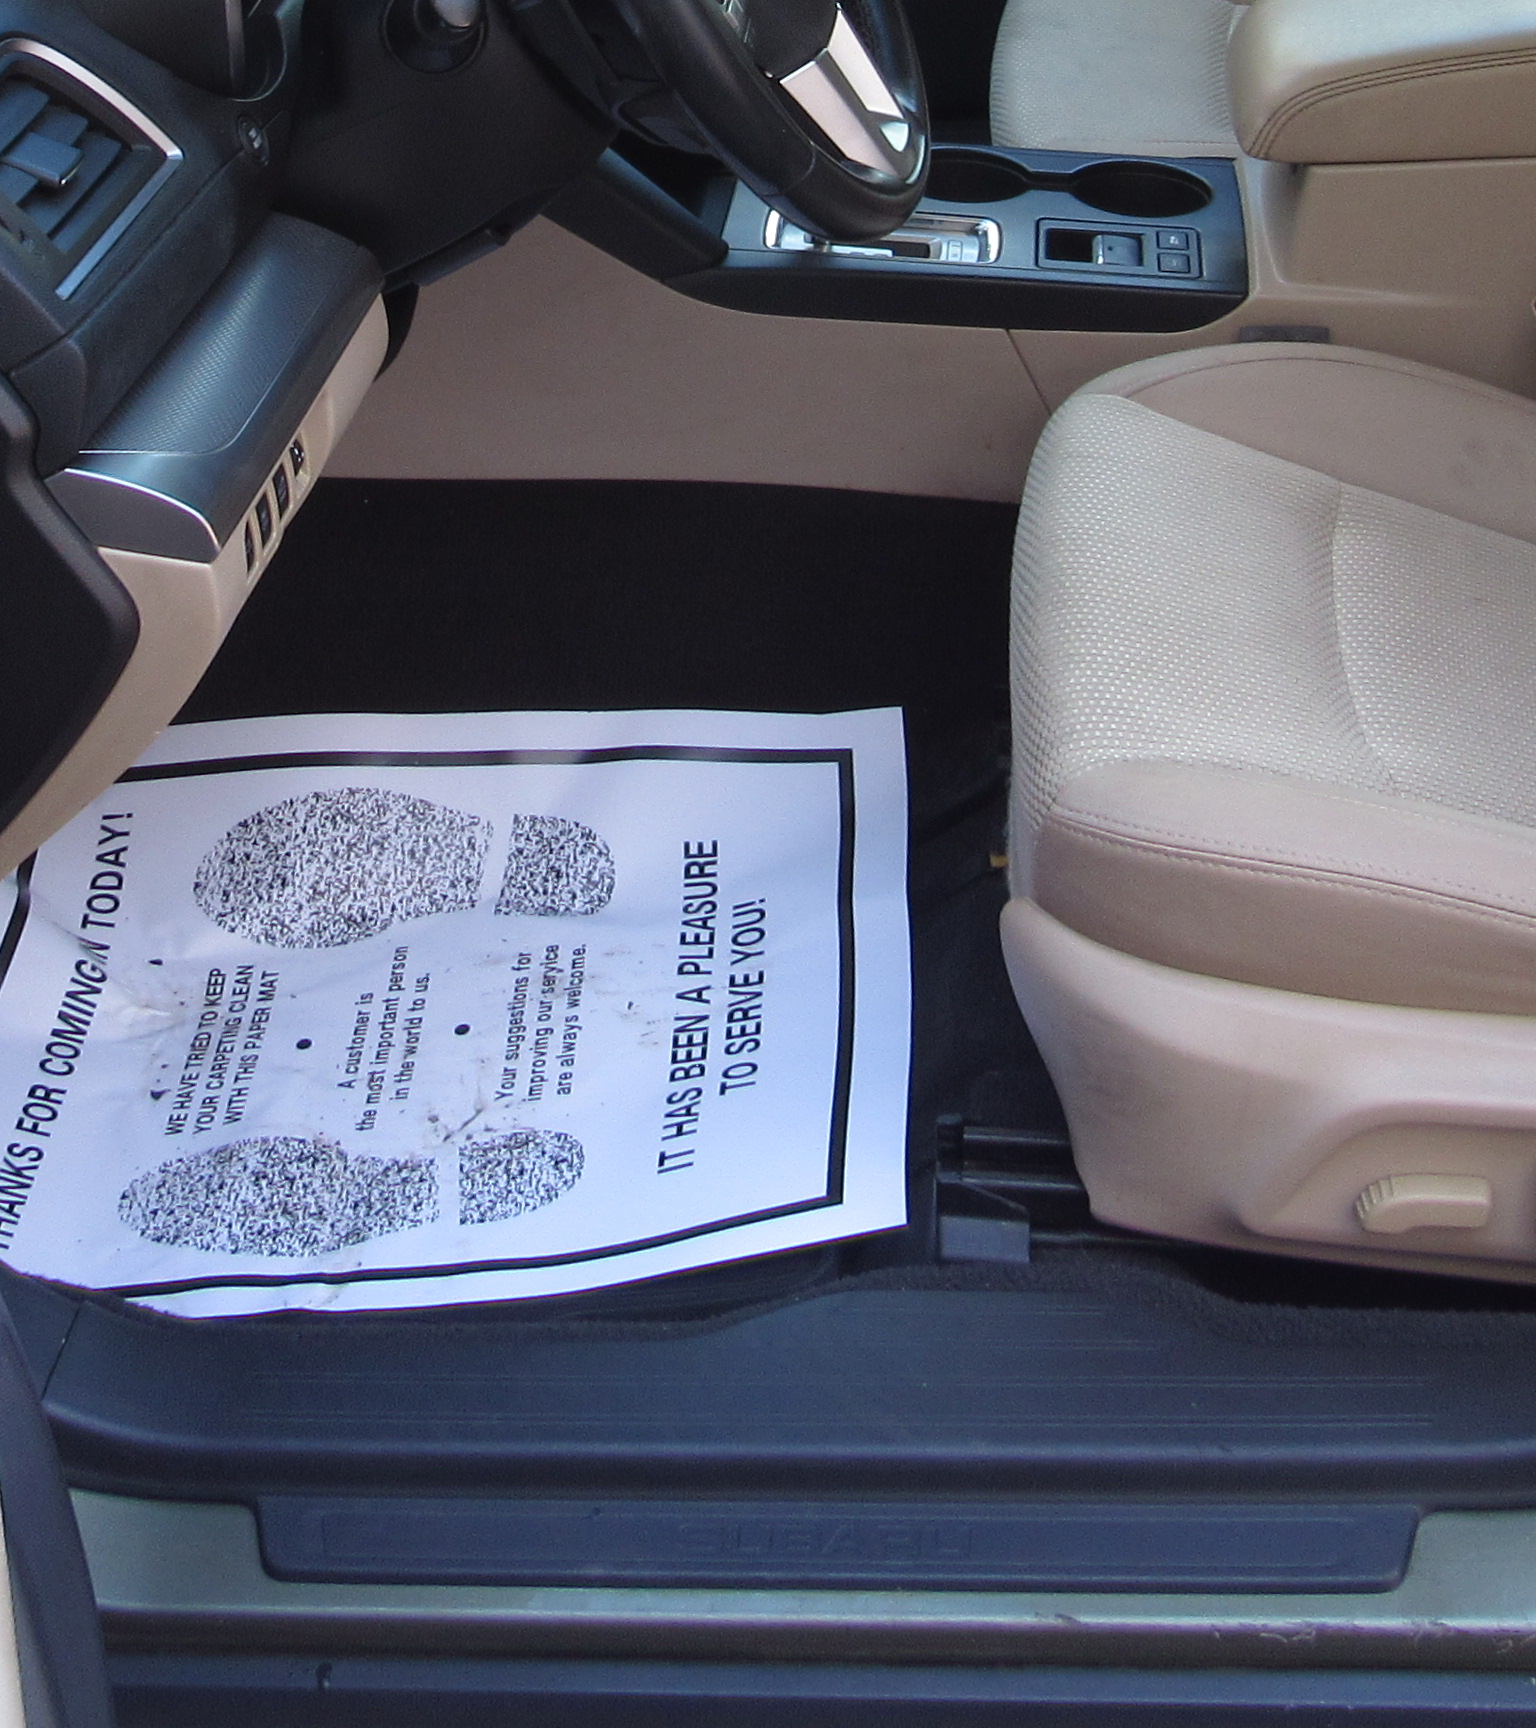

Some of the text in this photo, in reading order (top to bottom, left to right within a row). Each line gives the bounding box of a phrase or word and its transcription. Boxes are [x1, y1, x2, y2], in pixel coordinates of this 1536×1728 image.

[80, 811, 135, 929] TODAY!
[39, 959, 108, 1077] COMING
[164, 967, 227, 1135] WE HAVE TRIED TO KEEP
[192, 964, 254, 1135] YOUR CARPETING CLEAN
[222, 970, 279, 1126] WITH THIS PAPER MAT
[337, 992, 374, 1089] A customer is
[355, 945, 409, 1132] the most important person
[389, 973, 430, 1101] in the world to us.
[494, 952, 533, 1101] Your suggestions for
[522, 944, 565, 1102] improving our service
[556, 944, 587, 1096] are always welcome.
[657, 839, 719, 1175] IT HAS BEEN A PLEASURE
[719, 897, 767, 1097] TO SERVE YOU!
[15, 1083, 67, 1138] FOR
